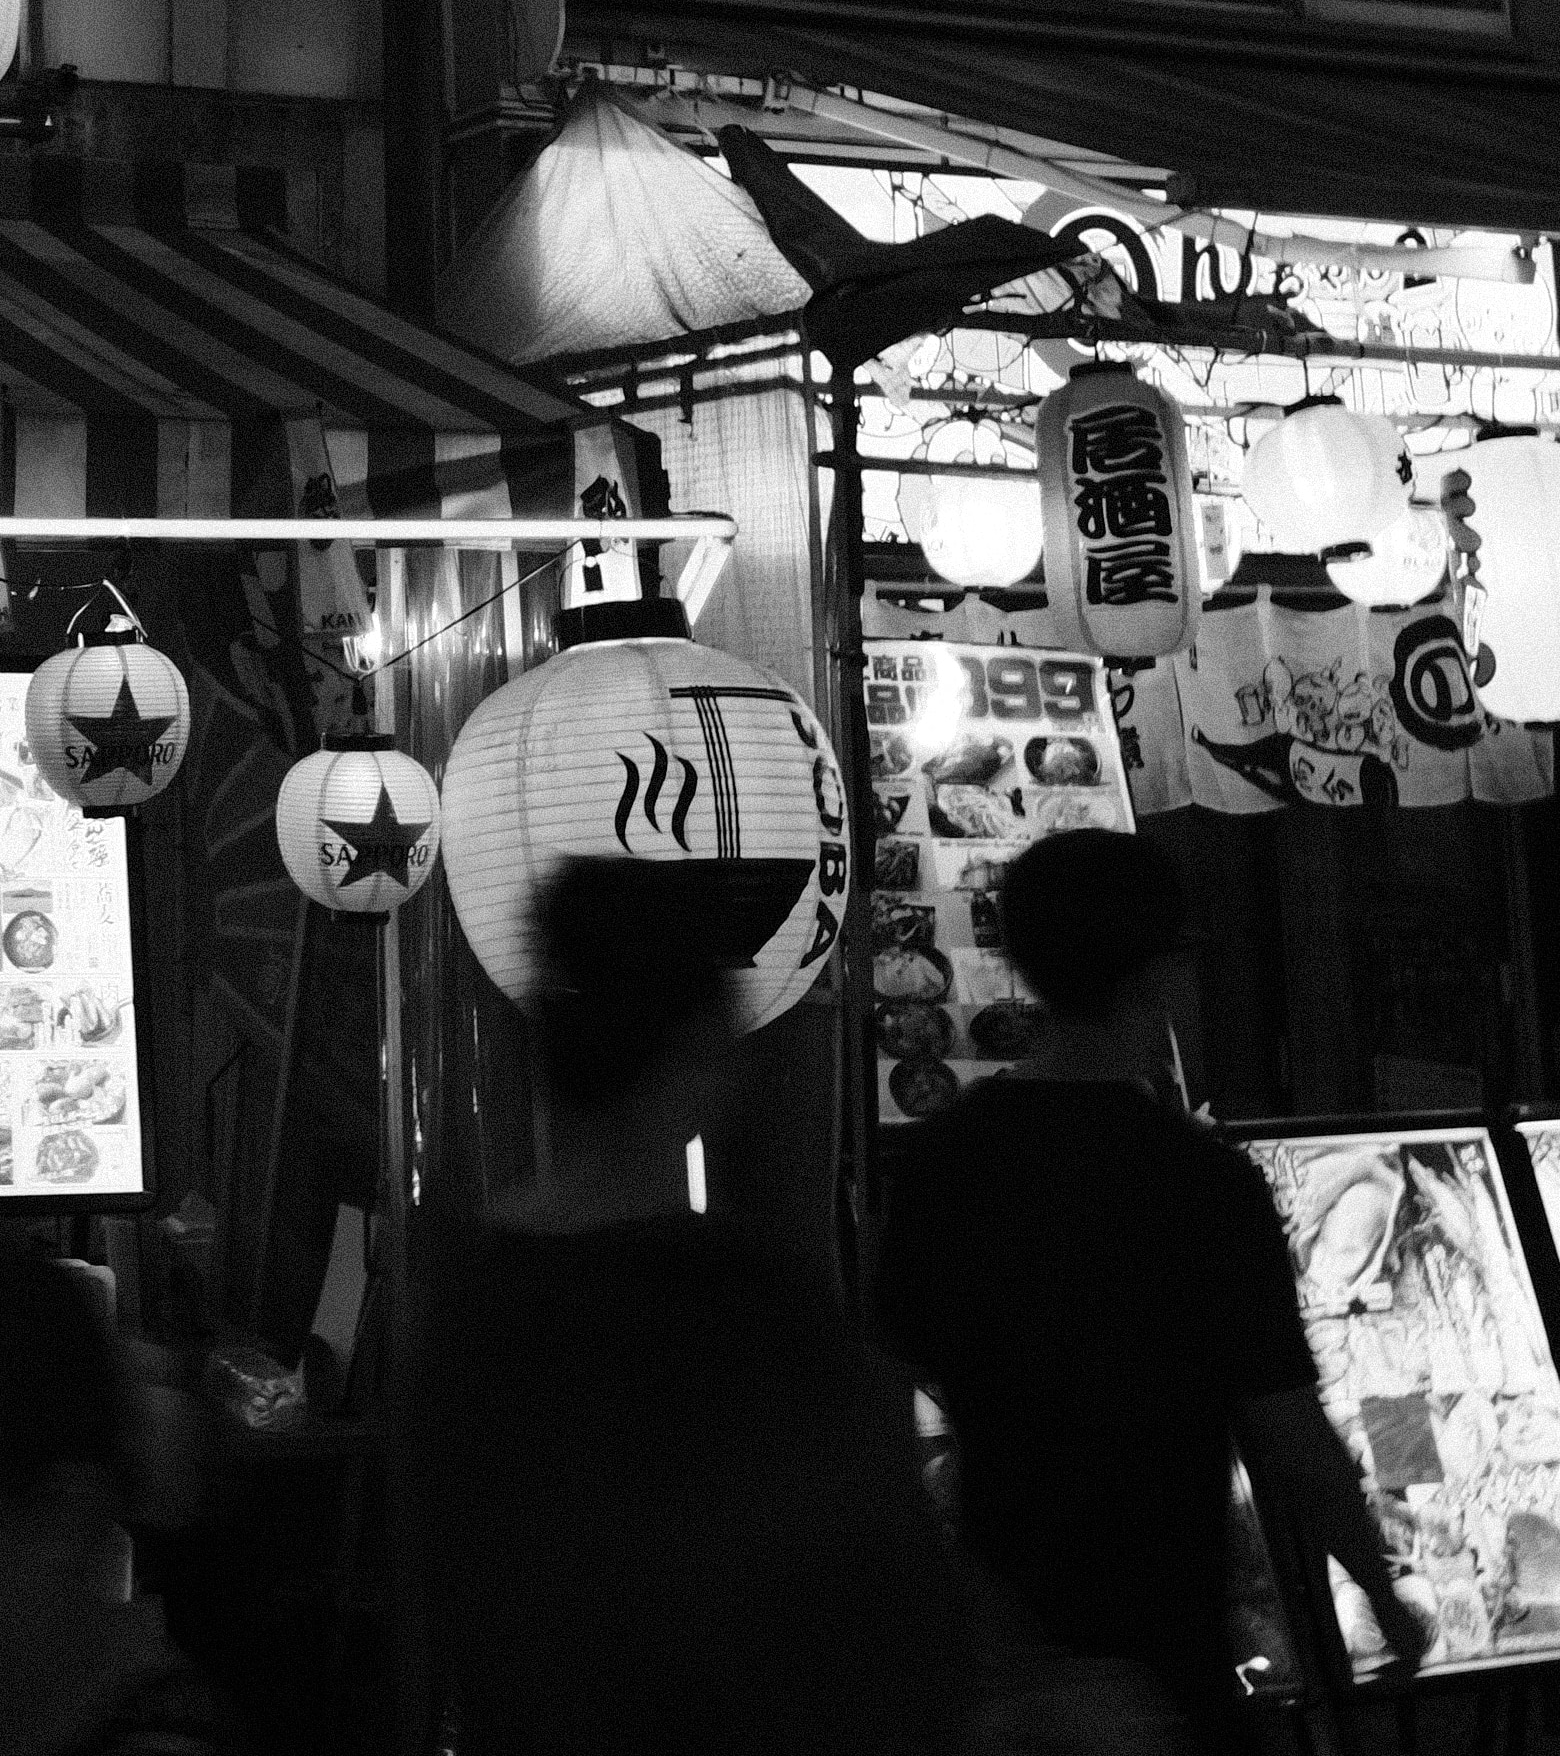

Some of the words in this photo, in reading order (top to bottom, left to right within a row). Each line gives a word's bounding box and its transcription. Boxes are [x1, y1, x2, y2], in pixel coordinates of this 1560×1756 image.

[1069, 403, 1179, 606] 居酒屋
[63, 740, 176, 770] SAPPORO
[319, 840, 431, 869] SAPPORO
